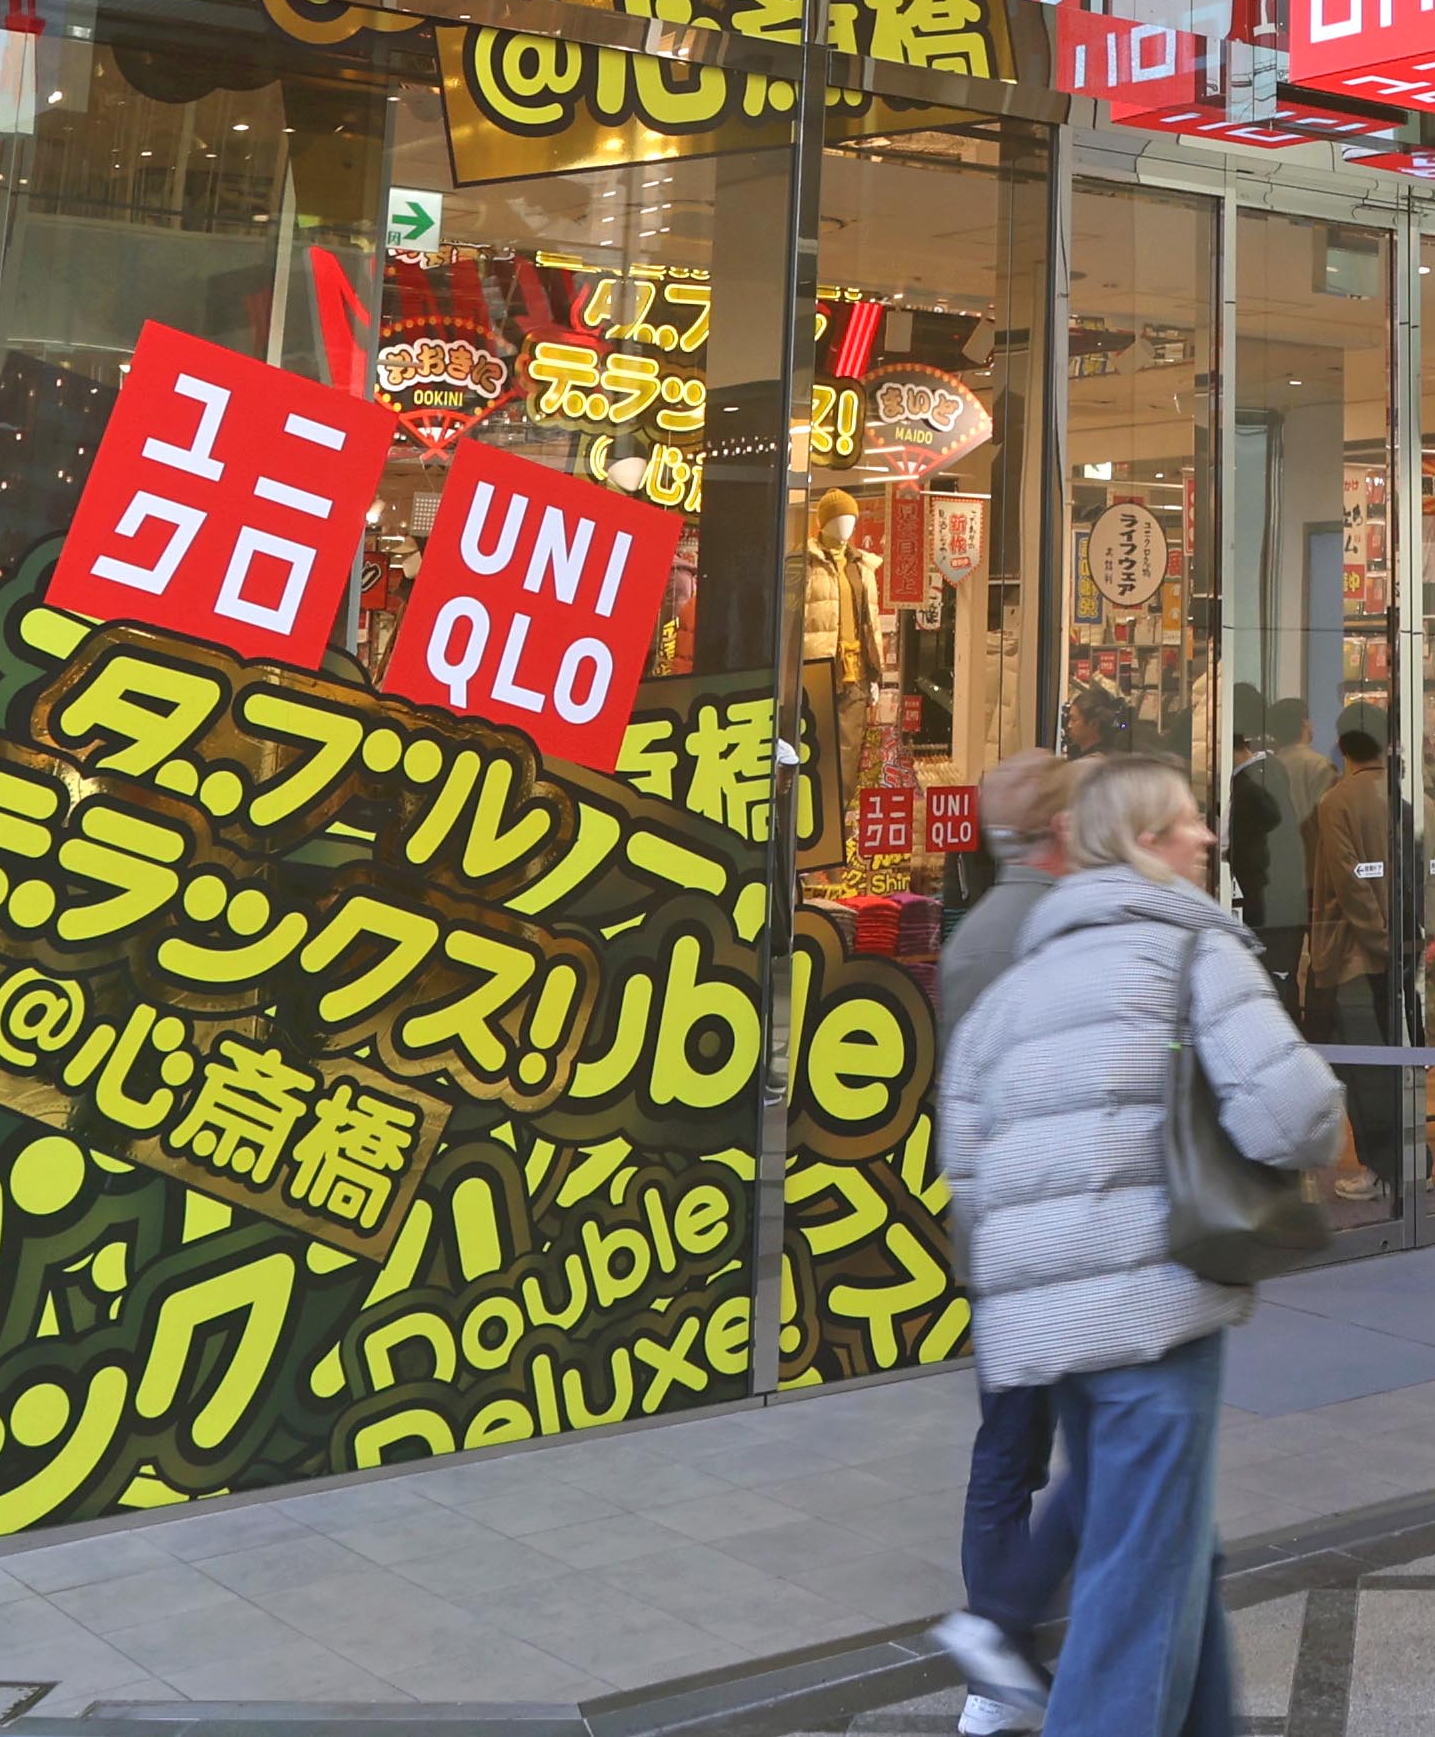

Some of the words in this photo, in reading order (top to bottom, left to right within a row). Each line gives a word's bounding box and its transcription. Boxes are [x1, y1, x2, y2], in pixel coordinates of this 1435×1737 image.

[413, 389, 463, 408] OOKINI
[880, 385, 962, 430] まいど
[142, 373, 347, 520] ユニ
[895, 426, 933, 446] MAIDO
[90, 490, 317, 637] クロ
[459, 479, 634, 618] UNI
[1118, 513, 1139, 597] ライフウェア
[426, 597, 614, 726] QLO
[867, 796, 906, 819] ユニ
[932, 794, 969, 817] UNI
[865, 824, 906, 847] クロ
[932, 821, 972, 845] QLO
